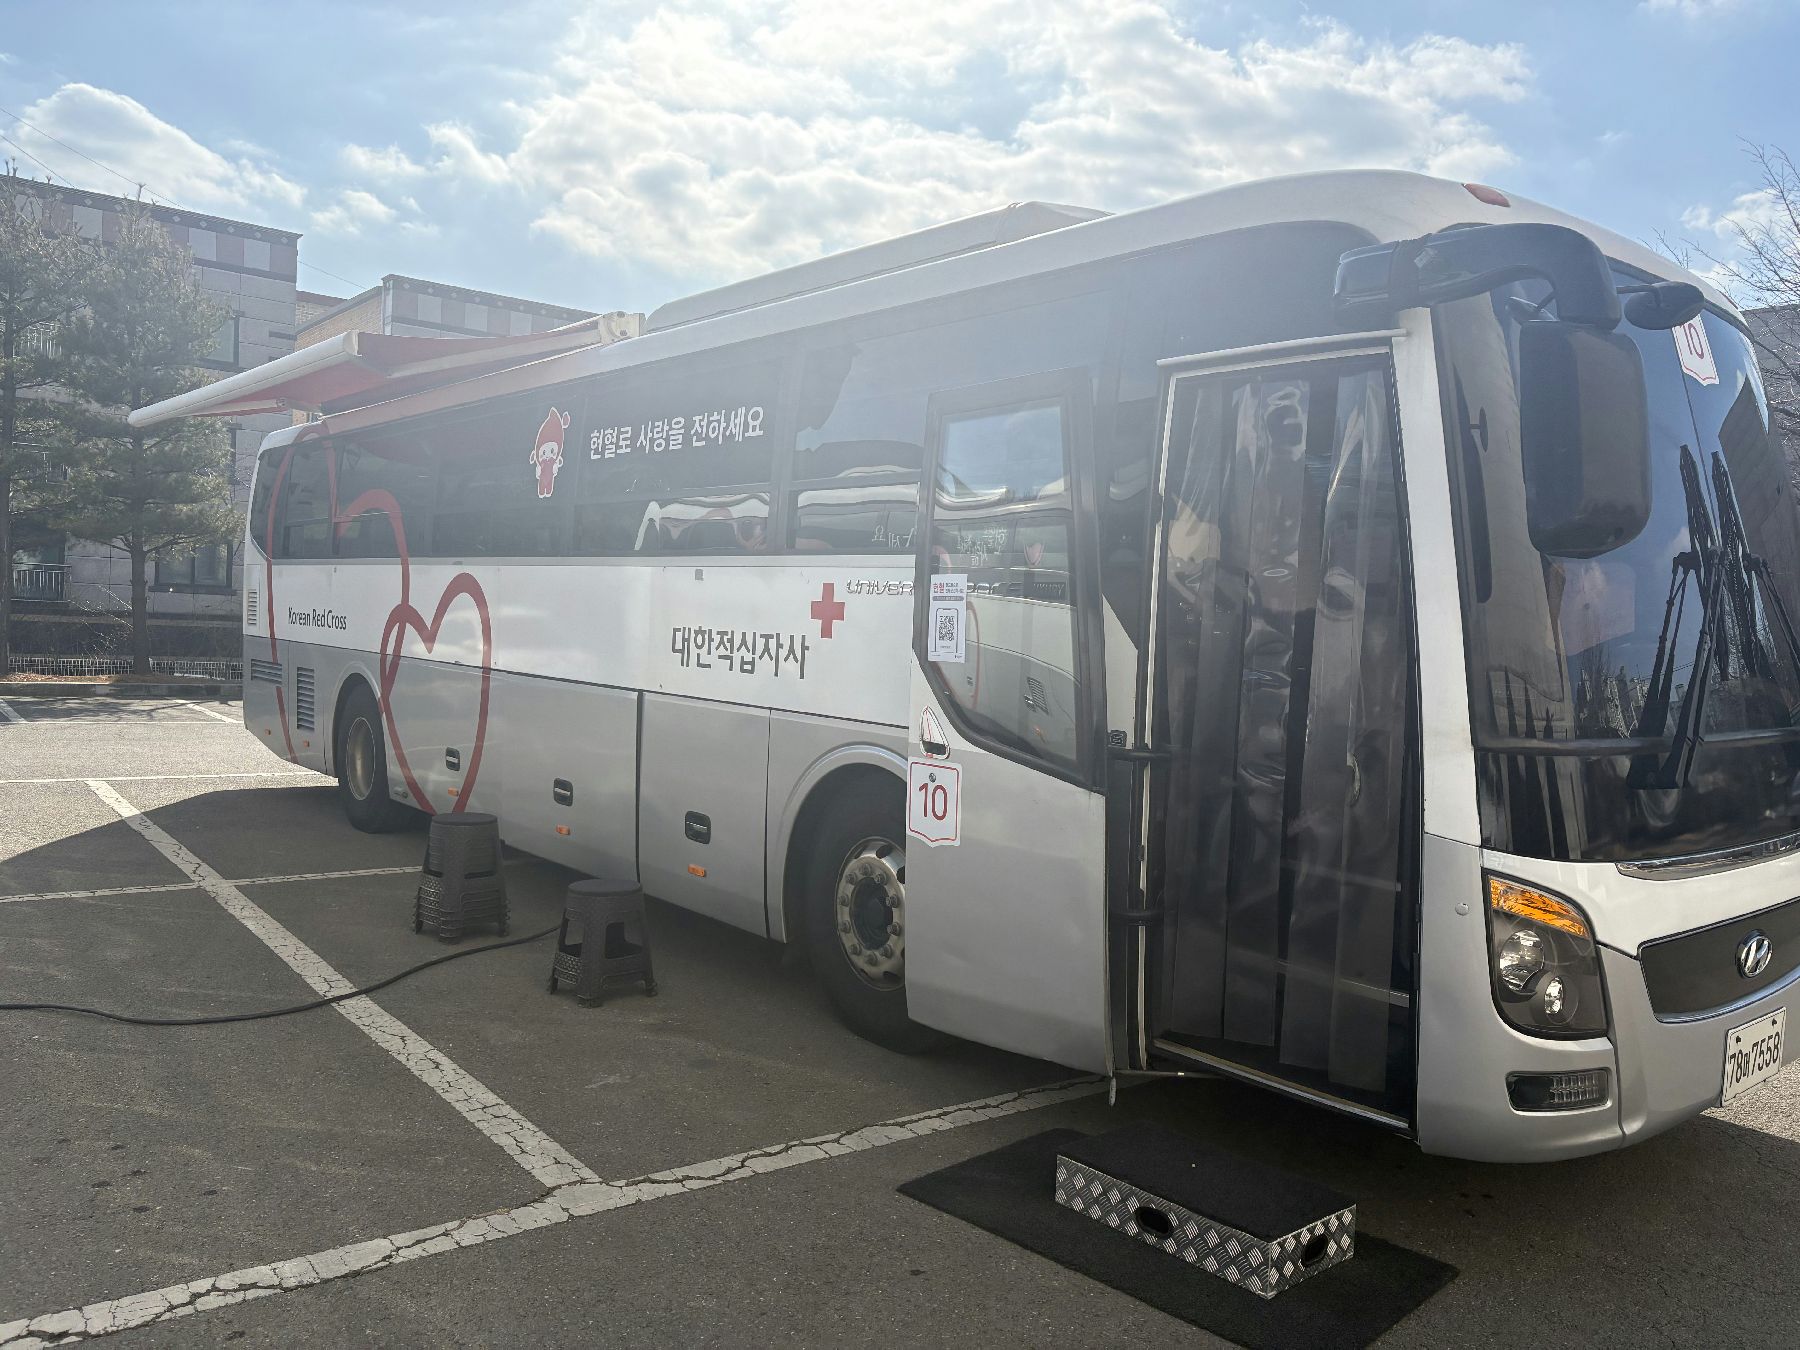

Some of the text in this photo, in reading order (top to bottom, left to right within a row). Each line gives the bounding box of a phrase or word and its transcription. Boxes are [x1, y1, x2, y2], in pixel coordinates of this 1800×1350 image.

[1680, 323, 1704, 359] 10
[590, 406, 764, 459] 헌혈로 사랑을 전하세요
[288, 606, 347, 630] Korean Red Cross
[671, 626, 810, 680] 대한적십자사
[918, 782, 948, 821] 10
